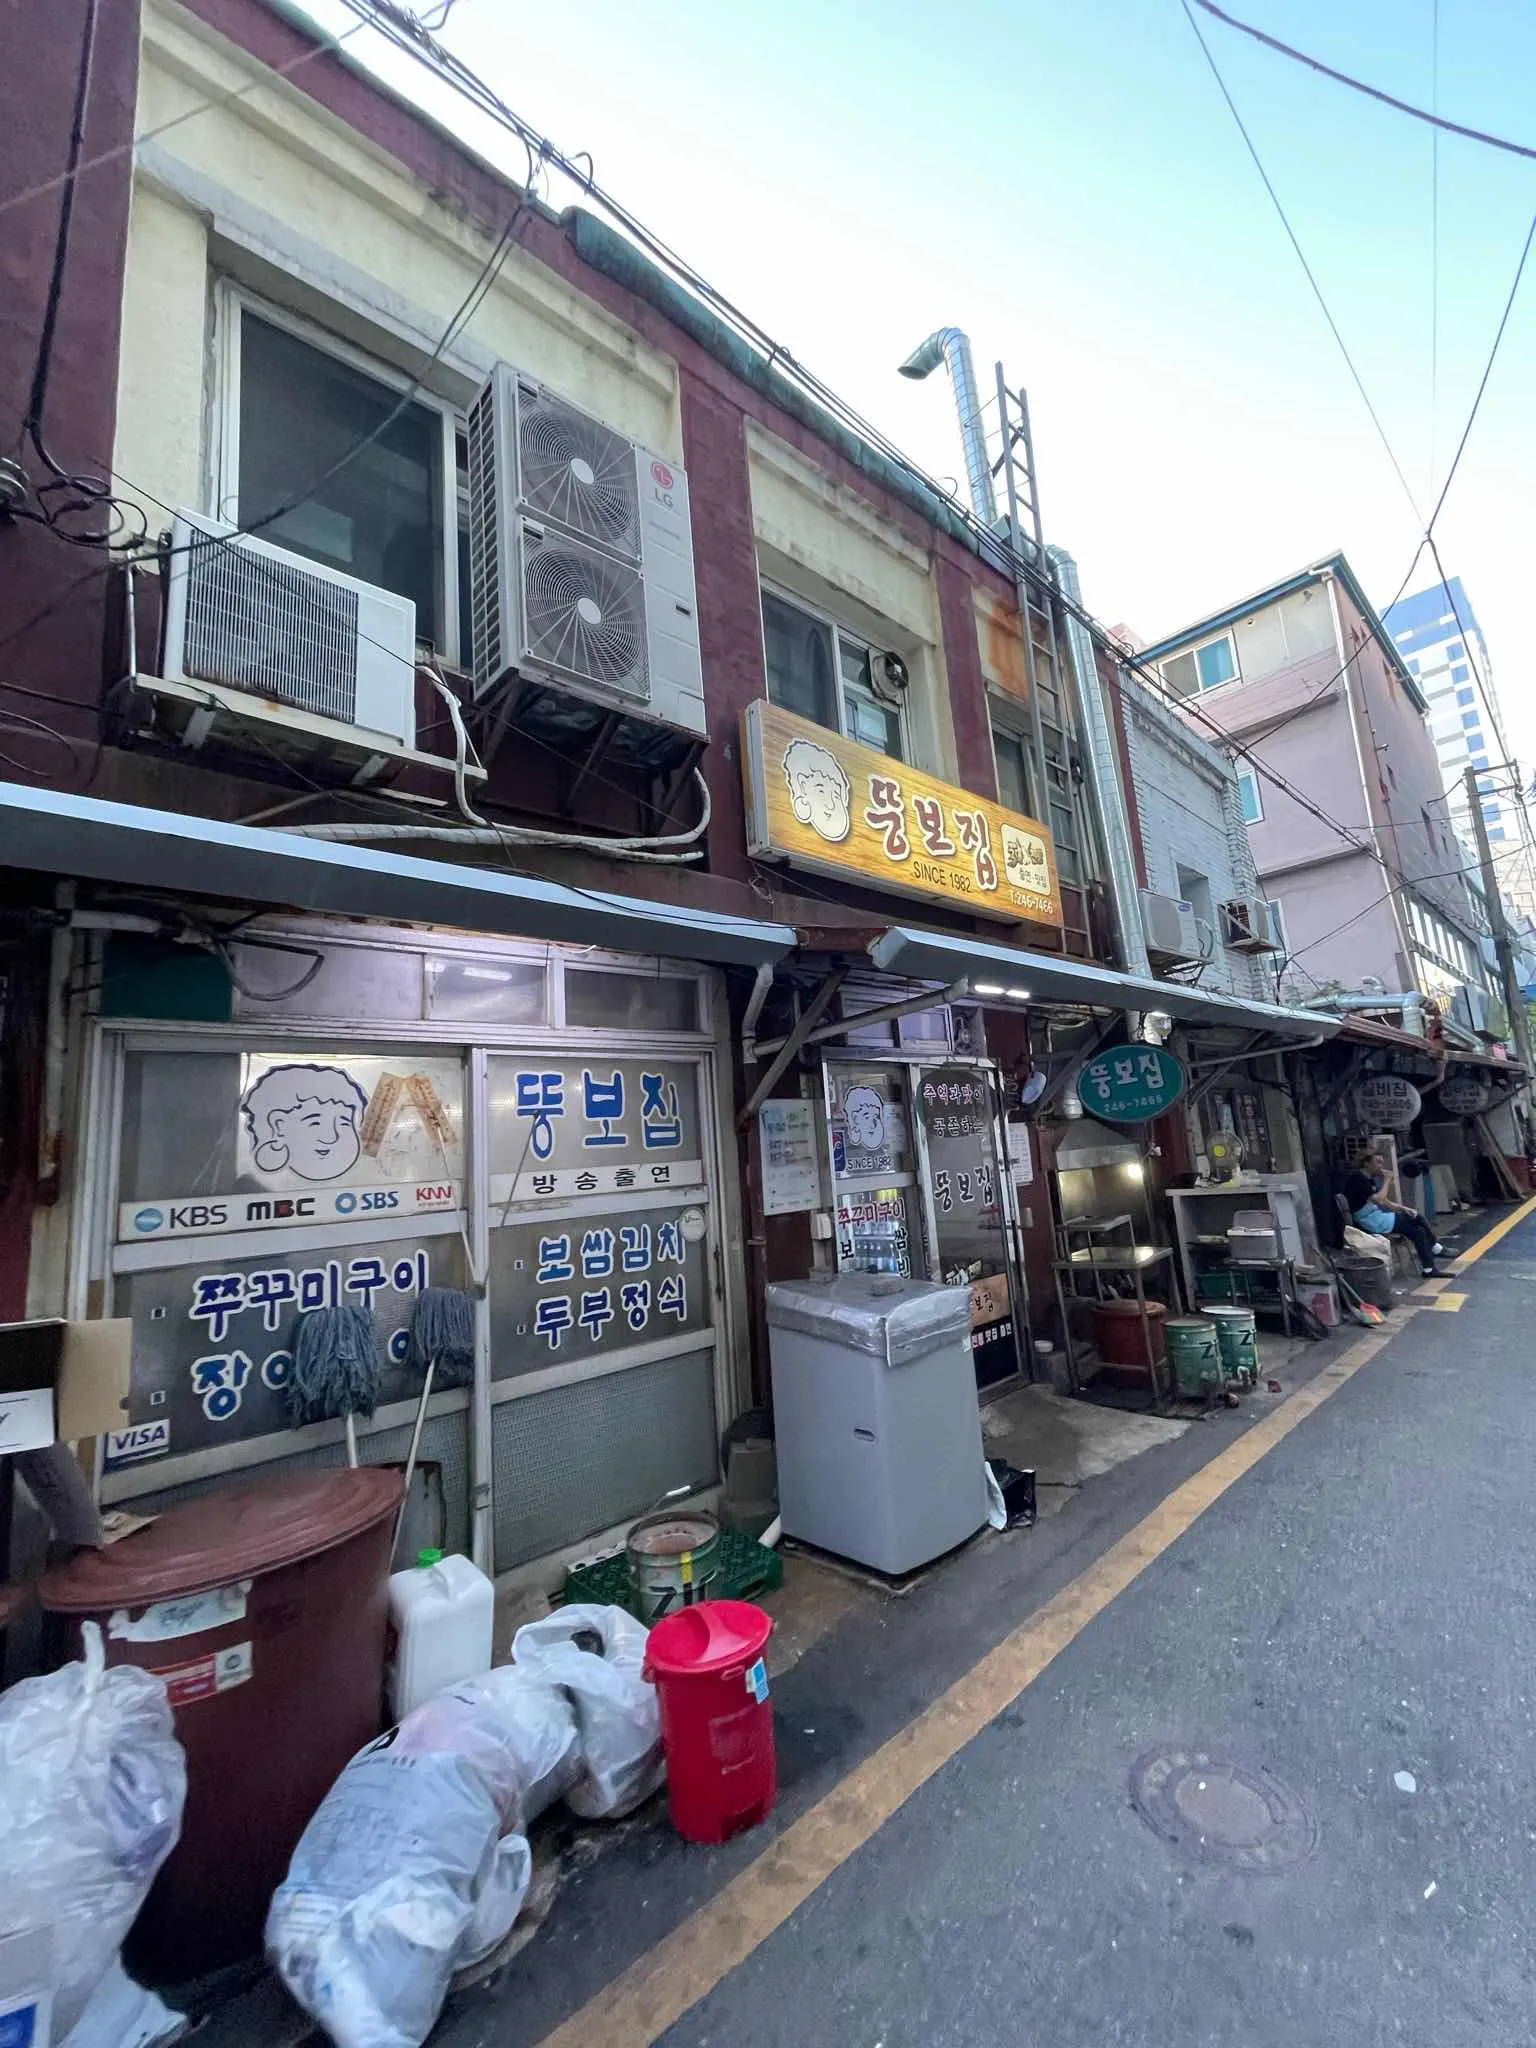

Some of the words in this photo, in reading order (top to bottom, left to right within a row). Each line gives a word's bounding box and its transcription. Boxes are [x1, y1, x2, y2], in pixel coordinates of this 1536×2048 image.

[655, 488, 674, 509] LG
[865, 775, 998, 890] 뚱보집
[913, 861, 945, 886] SINCE
[950, 873, 972, 893] 1982
[1089, 1053, 1165, 1099] 뚱보집
[516, 1069, 683, 1161] 뚱보집
[847, 1158, 874, 1171] SINCE
[933, 1163, 994, 1212] 뚱보집
[169, 1204, 229, 1229] KBS
[360, 1190, 400, 1211] SBS
[416, 1185, 453, 1201] KNN
[536, 1219, 687, 1284] 보쌈김치
[189, 1249, 430, 1342] 쭈꾸미구이
[534, 1273, 688, 1349] 두부정식
[975, 1291, 995, 1313] 보집
[113, 1425, 166, 1450] VISA
